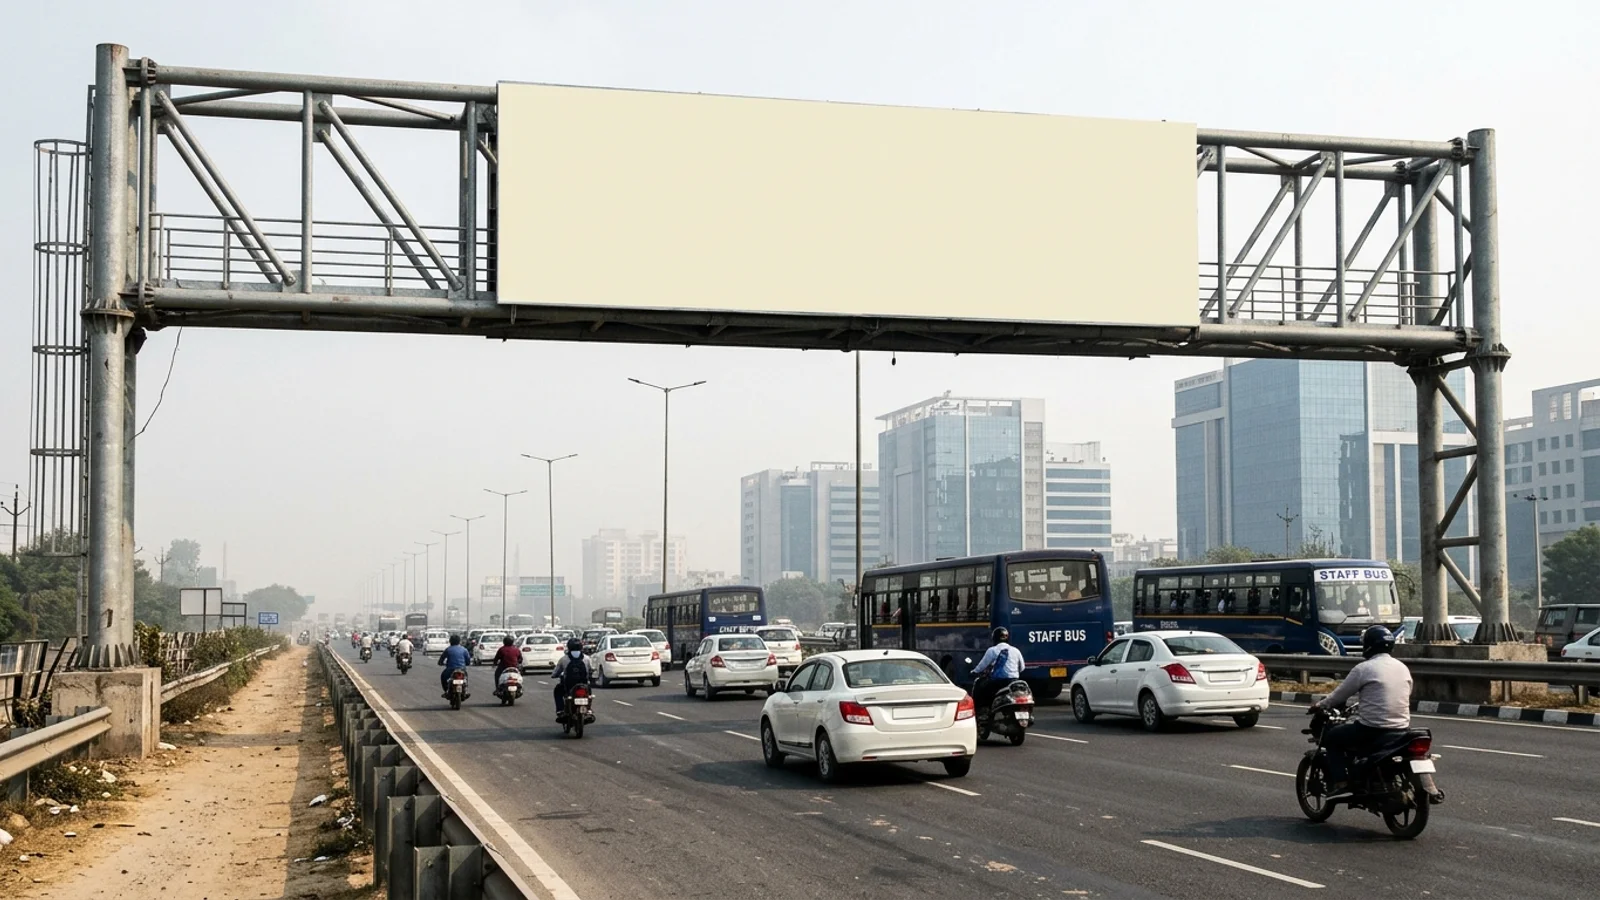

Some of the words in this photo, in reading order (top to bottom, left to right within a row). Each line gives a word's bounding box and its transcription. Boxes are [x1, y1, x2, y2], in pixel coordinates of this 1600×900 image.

[1319, 570, 1359, 580] STAFF
[1363, 570, 1388, 579] BUS
[1028, 630, 1062, 643] STAFF
[1064, 629, 1087, 642] BUS
